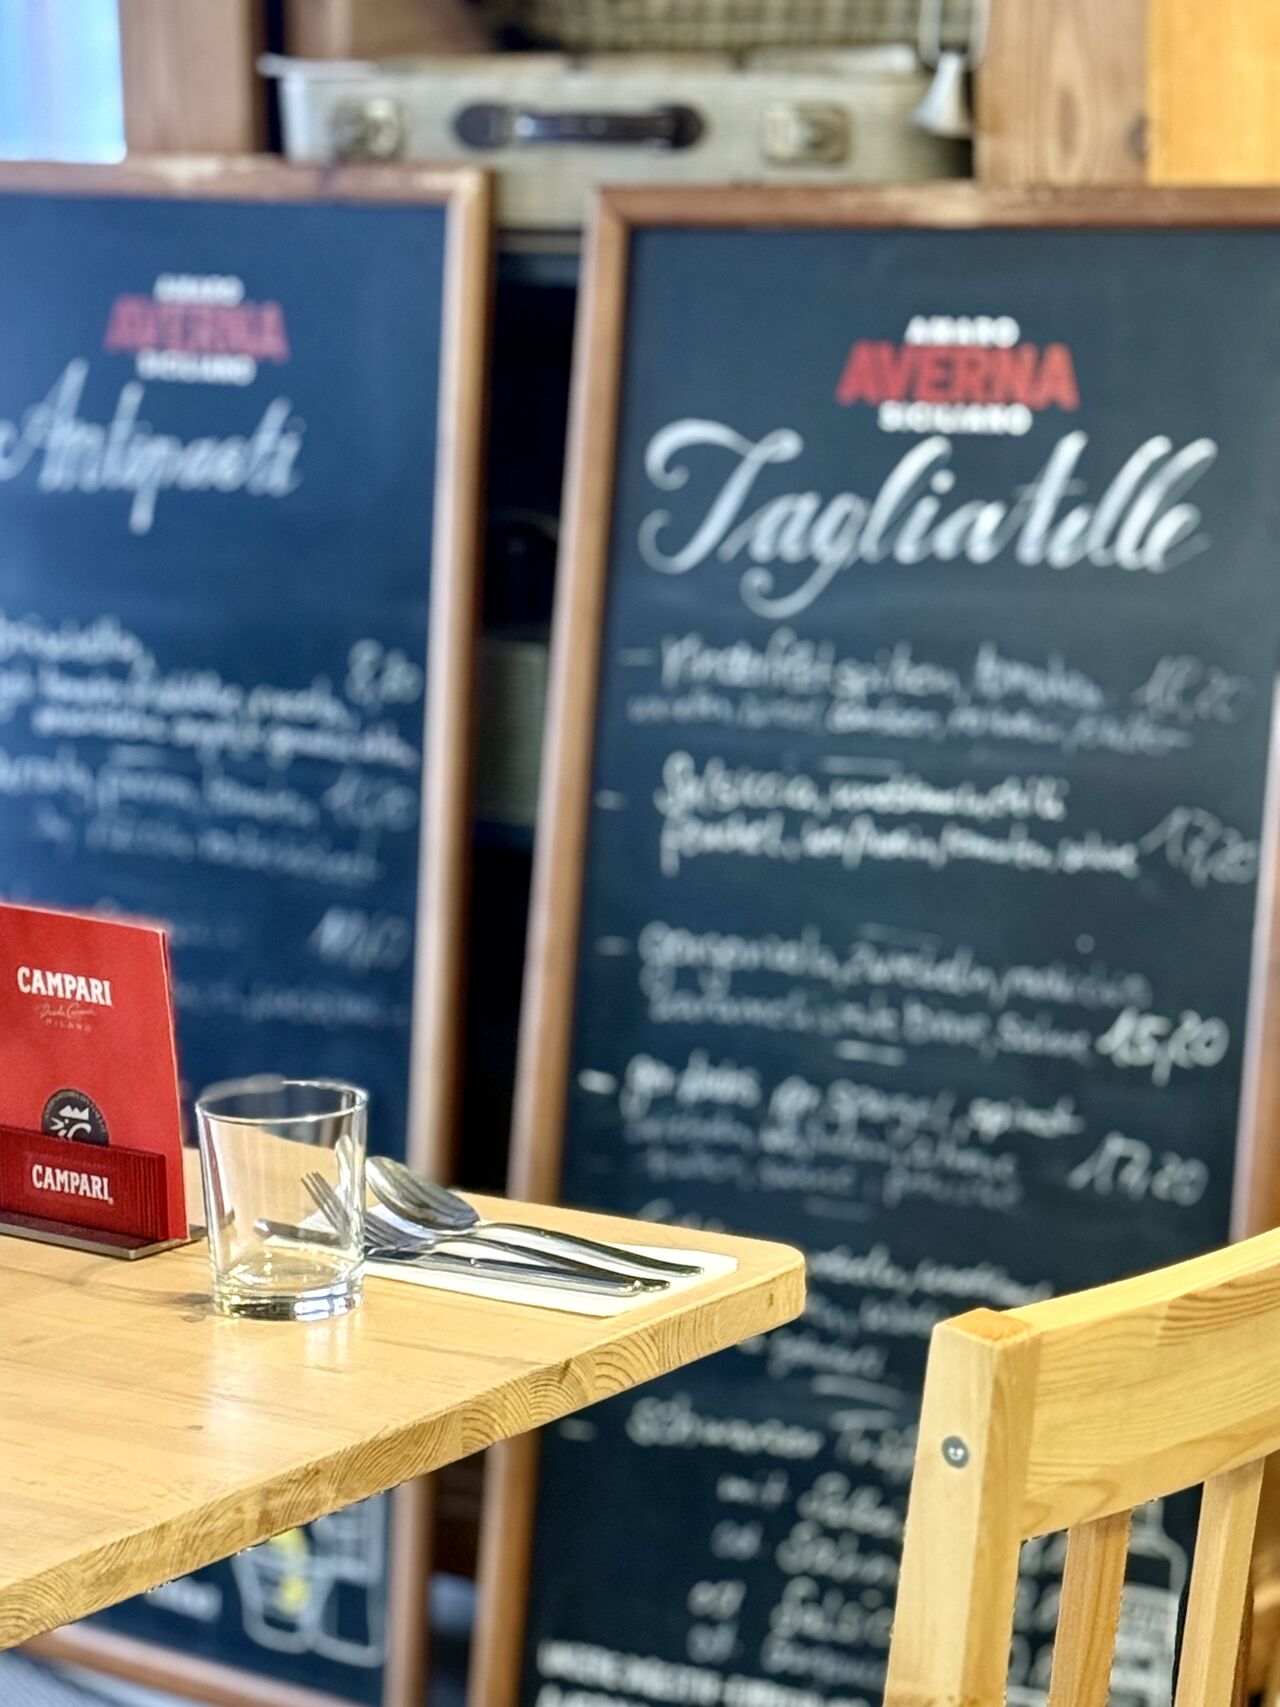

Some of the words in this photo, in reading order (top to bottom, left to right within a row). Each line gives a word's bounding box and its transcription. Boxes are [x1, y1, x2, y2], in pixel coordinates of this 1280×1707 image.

[835, 339, 1081, 411] AVERNA
[638, 418, 1218, 618] Tagliatelle
[17, 966, 112, 1006] CAMPARI
[32, 1164, 112, 1202] CAMPARI
